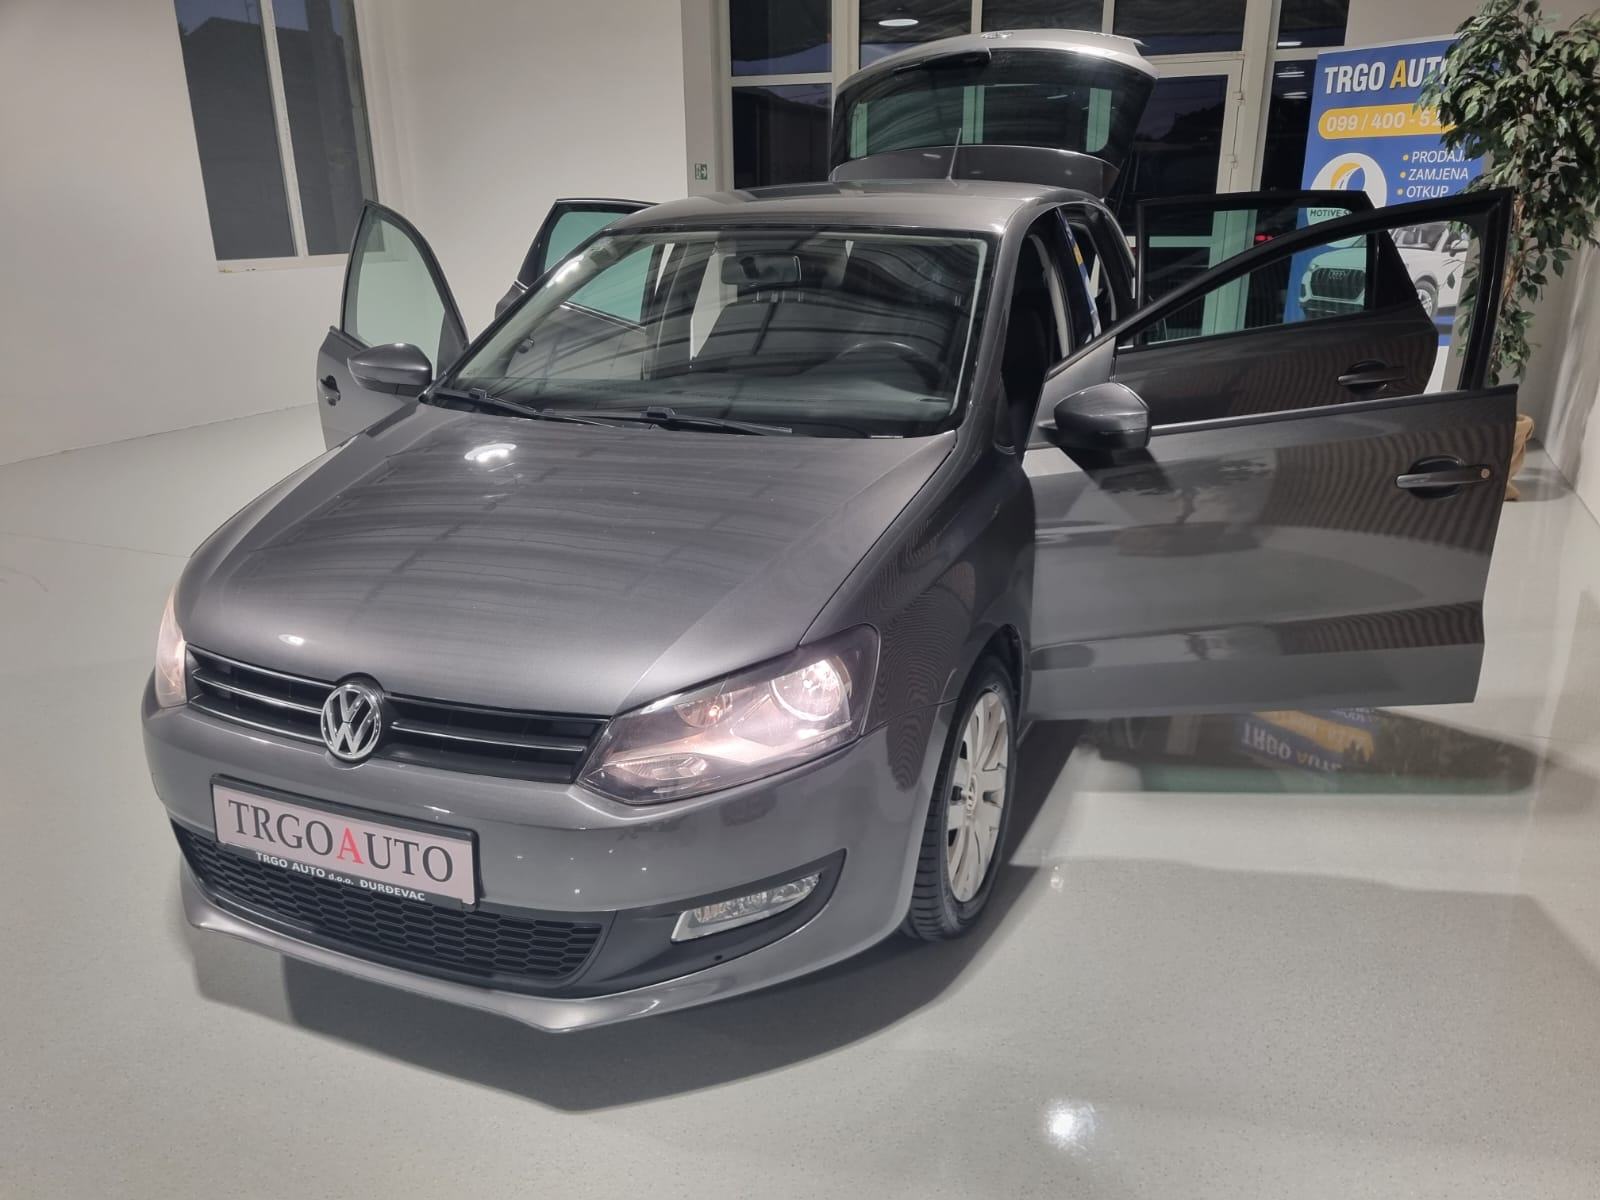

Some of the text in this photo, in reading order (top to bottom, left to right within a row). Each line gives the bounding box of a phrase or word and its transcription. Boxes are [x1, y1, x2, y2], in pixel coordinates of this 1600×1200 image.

[1324, 61, 1386, 94] TRGO
[1326, 114, 1359, 133] 099
[1371, 111, 1406, 130] 400
[1408, 167, 1469, 181] ZAMJENA
[1406, 185, 1449, 198] OTKUP
[228, 799, 454, 883] TRGOAUTO
[256, 852, 288, 868] TRGO
[291, 862, 326, 878] AUTO
[359, 879, 425, 901] ĐURĐEVAC
